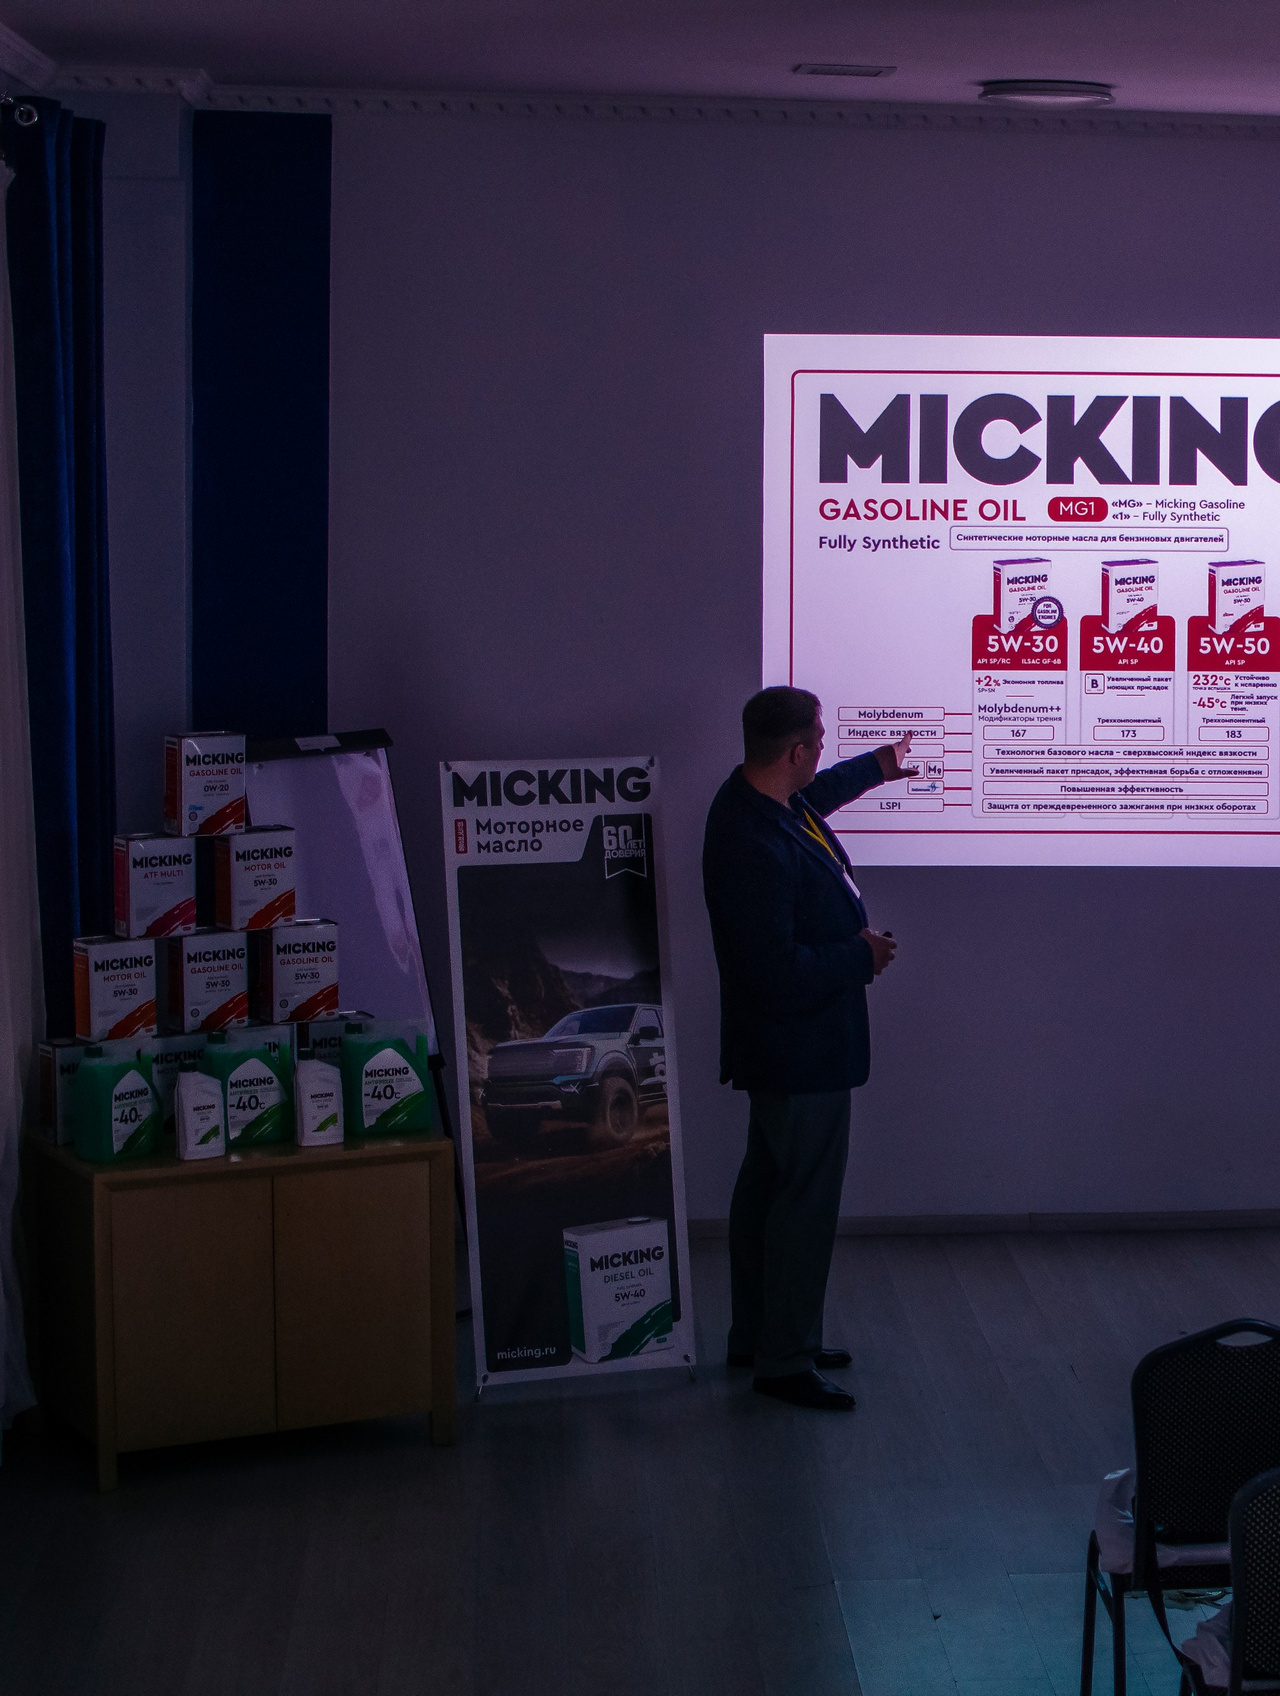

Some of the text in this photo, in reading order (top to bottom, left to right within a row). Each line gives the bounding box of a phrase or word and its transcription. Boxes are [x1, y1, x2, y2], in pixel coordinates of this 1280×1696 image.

[819, 498, 1026, 522] GASOLINE OIL
[1059, 501, 1096, 516] MG1
[1111, 500, 1245, 511] «MG» Micking Gasoline
[1112, 512, 1221, 523] «1» Fully Synthetic
[818, 535, 941, 552] Fully Synthetic
[956, 534, 1023, 542] Синтетические
[1026, 535, 1070, 543] моторные
[1101, 535, 1116, 543] для
[1119, 534, 1172, 543] бензиновых
[1174, 534, 1224, 544] двигателей
[1006, 574, 1049, 586] MICKING
[1115, 575, 1156, 586] MICKING
[1221, 576, 1263, 587] MICKING
[987, 635, 1059, 653] 5W-30
[1092, 636, 1164, 654] 5W-40
[1198, 637, 1270, 655] 5W-50
[975, 675, 1001, 687] +2%
[1090, 679, 1099, 689] B
[858, 709, 924, 720] Molybdenum
[978, 704, 1062, 715] Molybdenum++
[848, 728, 887, 738] Индекс
[1010, 729, 1027, 738] 167
[1120, 729, 1137, 738] 173
[1225, 730, 1242, 739] 183
[995, 748, 1046, 756] Технология
[1047, 748, 1087, 756] базового
[1122, 748, 1183, 757] сверхвысокий
[185, 752, 245, 767] MICKING
[189, 767, 243, 777] GASOLINE OIL
[989, 767, 1044, 775] Увеличенный
[1070, 768, 1112, 776] присадок,
[1114, 767, 1167, 776] эффективная
[1170, 767, 1199, 776] борьба
[452, 767, 651, 807] MICKING
[1060, 785, 1184, 794] Повышенная эффективность
[879, 801, 901, 810] LSPI
[987, 802, 1019, 811] Защита
[1166, 804, 1182, 812] при
[1216, 803, 1256, 812] оборотах
[476, 818, 584, 838] Моторное
[602, 825, 633, 850] 60
[477, 839, 543, 853] масло
[626, 839, 644, 849] ЛЕТ
[235, 846, 293, 862] MICKING
[604, 849, 646, 859] ДОВЕРИЯ
[132, 854, 193, 869] MICKING
[244, 862, 286, 872] MOTOR OIL
[143, 870, 184, 879] ATF MULTI
[253, 878, 278, 887] 5W-30
[276, 941, 336, 956] MICKING
[186, 947, 246, 964] MICKING
[279, 956, 334, 966] GASOLINE OIL
[93, 955, 154, 973] MICKING
[190, 963, 244, 975] GASOLINE OIL
[103, 973, 131, 982] MOTOR
[294, 972, 320, 981] 5W-30
[205, 979, 231, 989] 5W-30
[113, 988, 138, 998] 5W-30
[364, 1066, 410, 1079] MICKING
[229, 1076, 274, 1089] MICKING
[114, 1087, 149, 1103] MICKING
[192, 1103, 216, 1112] MICKING
[589, 1246, 665, 1272] MICKING
[603, 1267, 654, 1284] DIESEL OIL
[614, 1288, 646, 1302] 5W-40
[497, 1346, 557, 1360] micking.ru
